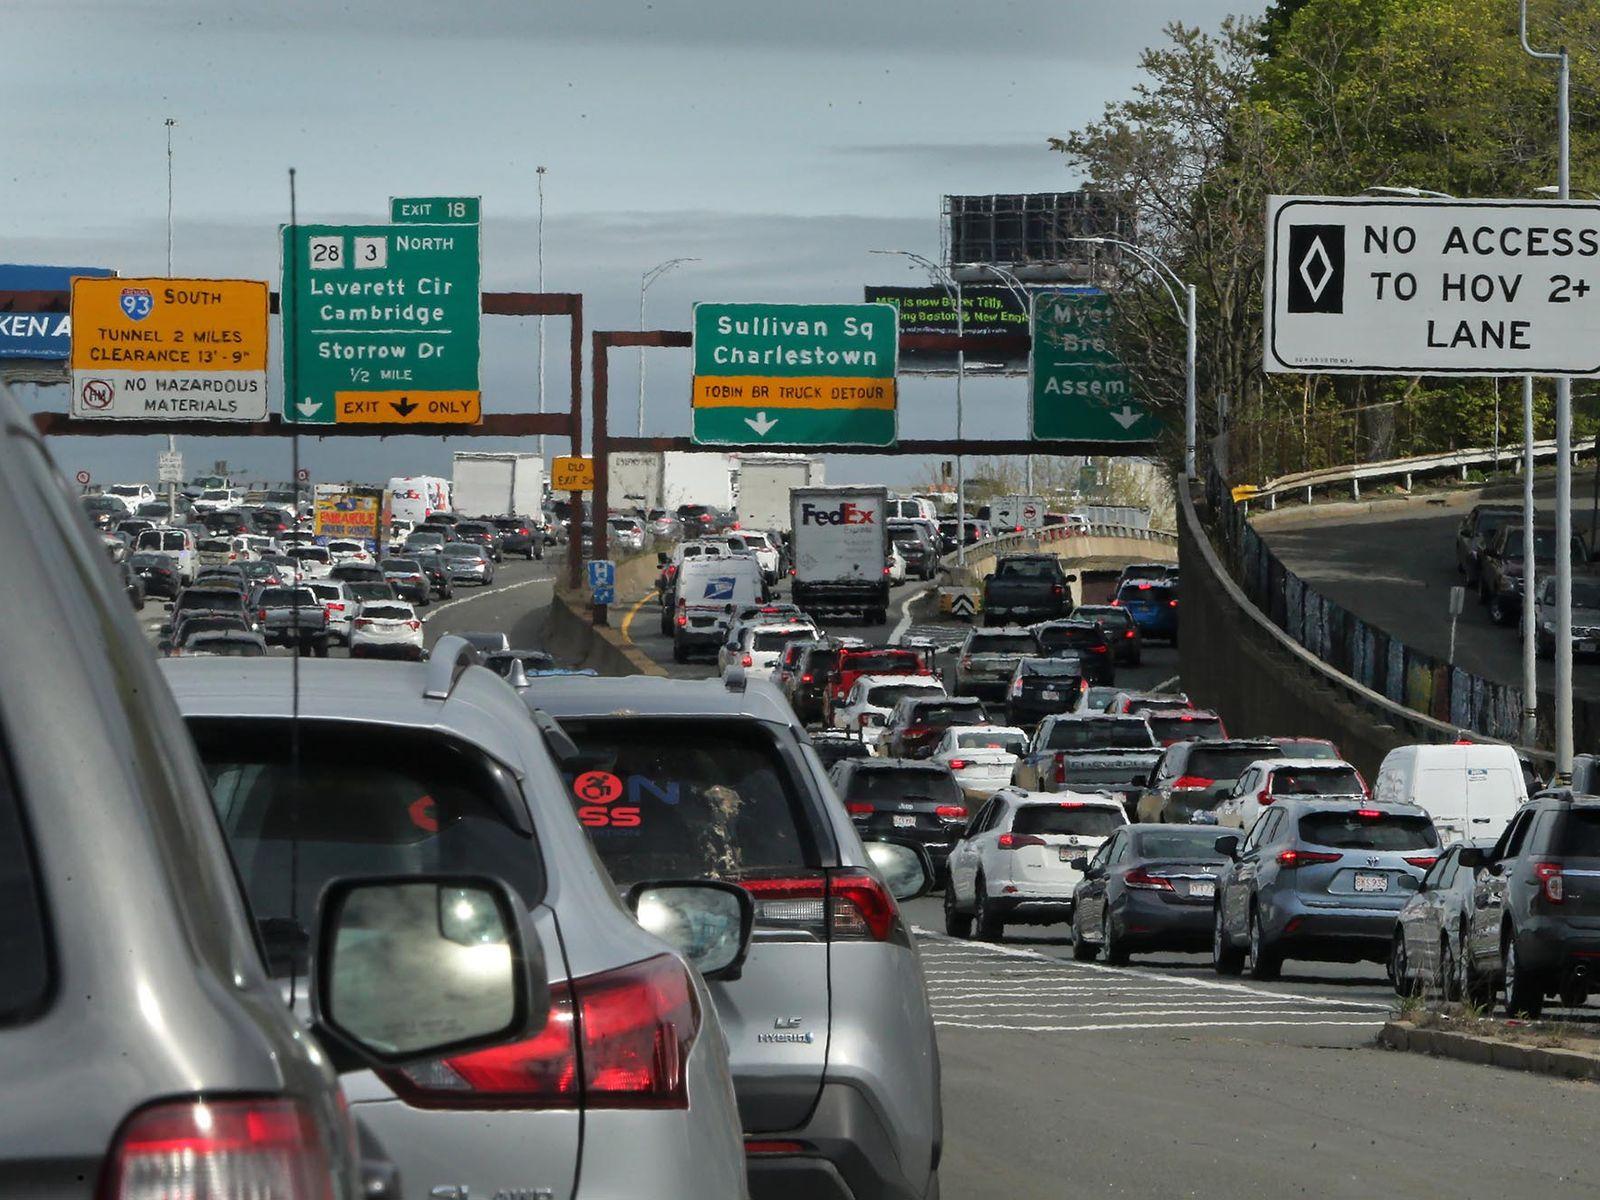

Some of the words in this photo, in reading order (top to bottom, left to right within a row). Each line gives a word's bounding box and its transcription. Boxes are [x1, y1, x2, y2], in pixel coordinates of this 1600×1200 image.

[401, 204, 432, 217] EXIT
[447, 202, 466, 218] 18
[1363, 225, 1417, 254] NO
[1441, 226, 1600, 256] ACCESS
[313, 244, 339, 262] 28
[364, 244, 377, 261] 3
[396, 235, 454, 251] NORTH
[310, 278, 405, 296] Leverett
[417, 277, 452, 296] Cir
[1370, 272, 1417, 301] TO
[1442, 273, 1523, 302] HOV
[1548, 274, 1590, 302] 2+
[123, 296, 150, 314] 93
[164, 288, 222, 305] SOUTH
[904, 297, 914, 307] is
[917, 298, 939, 307] now
[942, 296, 973, 307] Baer
[320, 304, 444, 325] Cambridge
[919, 311, 958, 321] Boston
[974, 311, 998, 322] New
[1001, 311, 1029, 324] Engl
[717, 315, 828, 337] Sullivan
[843, 316, 874, 340] Sq
[1427, 320, 1531, 350] LANE
[98, 328, 163, 343] TUNNEL
[173, 331, 184, 342] 2
[194, 330, 242, 343] MILES
[90, 348, 190, 362] CLEARANCE
[318, 341, 406, 360] Storrow
[418, 342, 444, 359] Dr
[713, 345, 877, 366] Charlestown
[380, 370, 412, 381] MILE
[125, 378, 147, 391] NO
[156, 378, 258, 393] HAZARDOUS
[705, 385, 743, 398] TOBIN
[751, 385, 769, 398] BR
[779, 386, 822, 399] TRUCK
[831, 386, 884, 400] DETOUR
[1044, 376, 1131, 395] Assem
[144, 398, 237, 413] MATERIALS
[343, 401, 380, 414] EXIT
[428, 400, 471, 414] ONLY
[567, 462, 585, 472] OLD
[558, 475, 577, 486] EXIT
[802, 502, 875, 527] FedEx
[774, 1017, 803, 1029] LE
[757, 1032, 805, 1043] HYBRID
